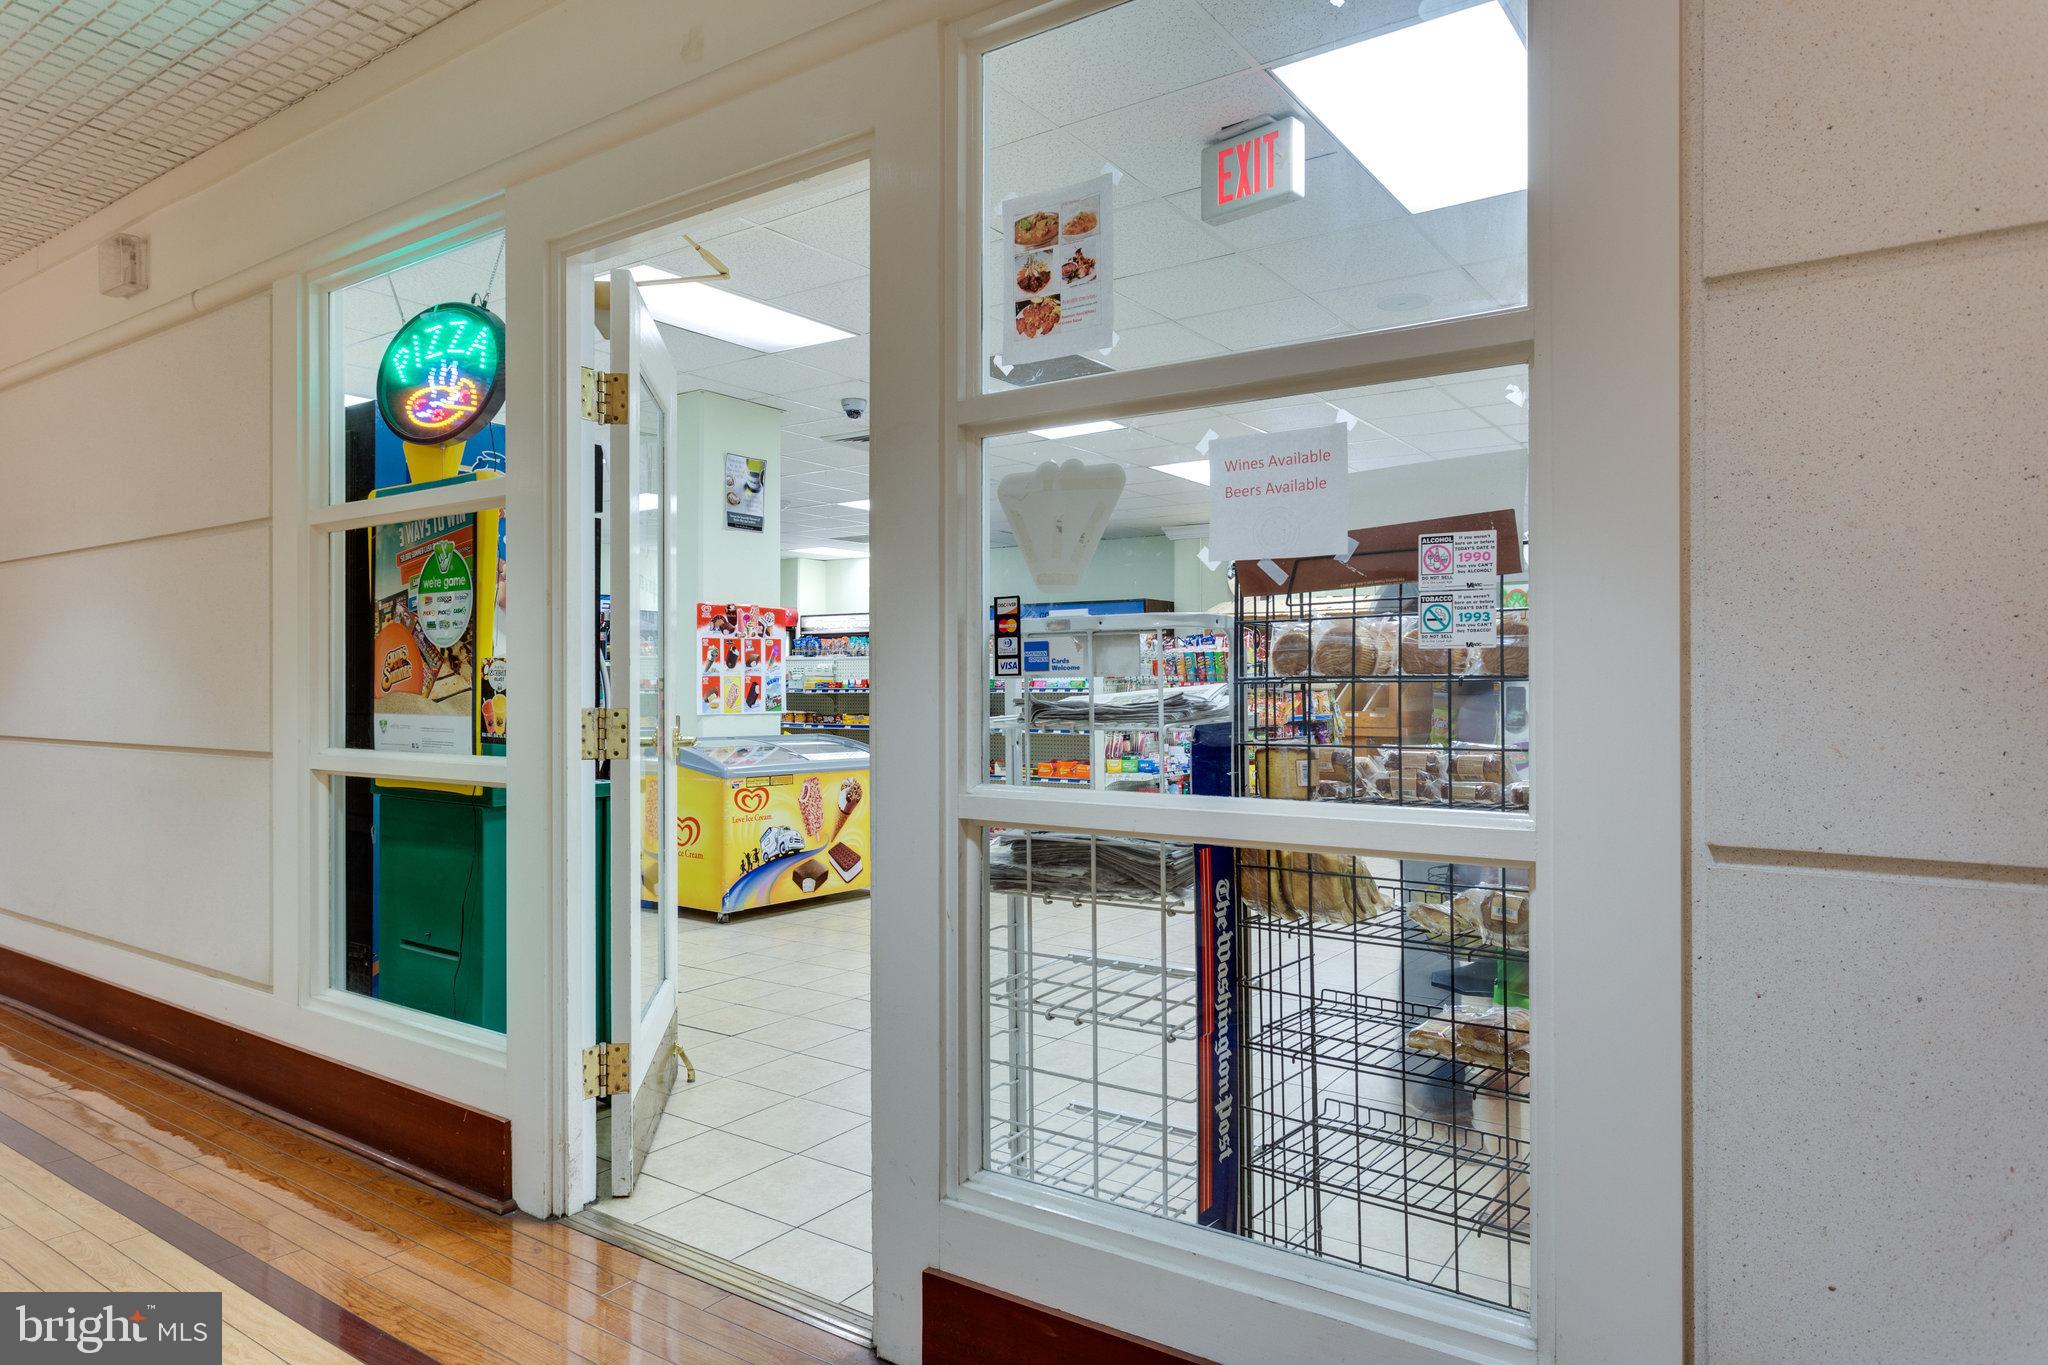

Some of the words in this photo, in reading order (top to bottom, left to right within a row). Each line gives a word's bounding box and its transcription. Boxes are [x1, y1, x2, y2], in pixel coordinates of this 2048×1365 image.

[1217, 130, 1278, 206] EXIT
[393, 319, 489, 383] PIZZA
[1224, 459, 1264, 472] Wines
[1268, 449, 1331, 467] Available
[1225, 486, 1261, 499] Beers
[1266, 477, 1327, 495] Available
[405, 519, 431, 544] WAYS
[433, 516, 445, 533] TO
[1422, 536, 1454, 544] ALCOHOL
[1458, 551, 1491, 562] 1990
[423, 576, 441, 588] we're
[443, 576, 466, 589] game
[1458, 612, 1491, 622] 1993
[1000, 661, 1018, 670] VISA
[685, 849, 704, 859] Cream
[1213, 878, 1231, 931] The
[1213, 930, 1234, 1098] Washington
[1213, 1094, 1234, 1164] Post
